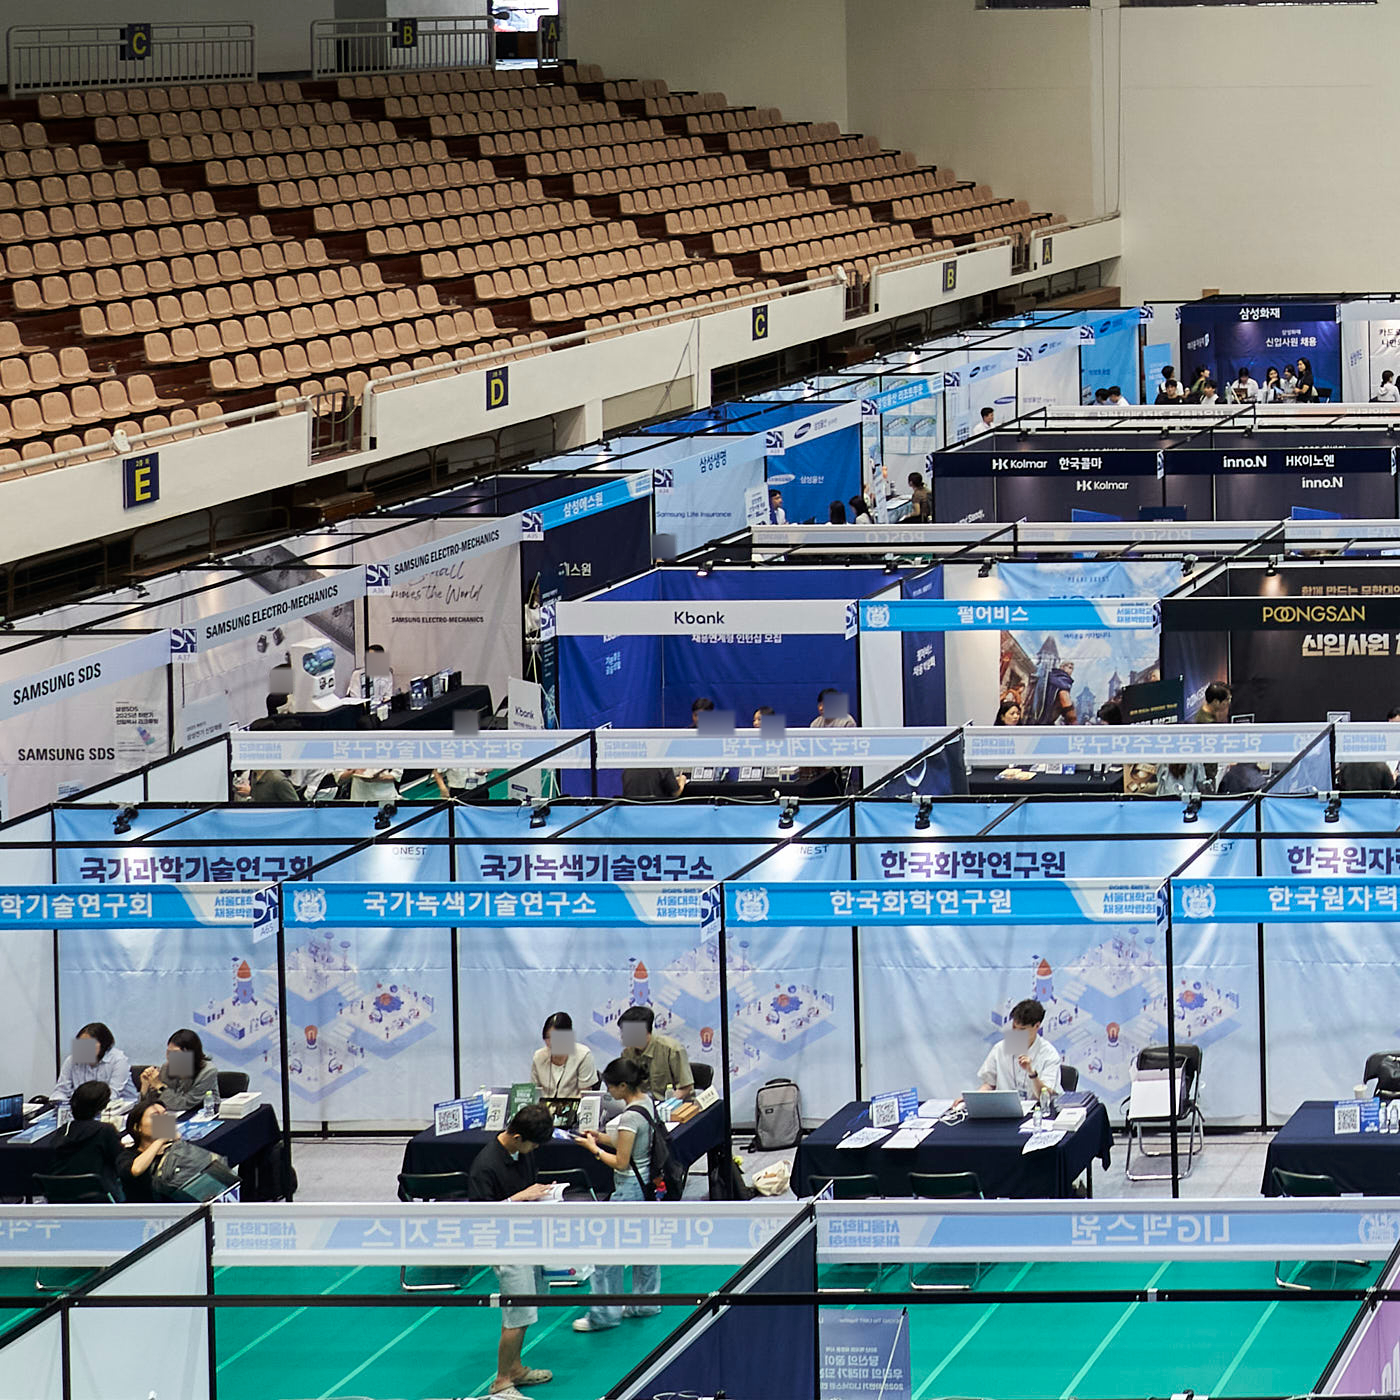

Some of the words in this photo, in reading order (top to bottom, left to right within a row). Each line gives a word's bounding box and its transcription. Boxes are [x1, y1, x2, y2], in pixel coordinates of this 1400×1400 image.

[402, 25, 414, 46] B
[547, 21, 556, 41] A
[132, 31, 146, 56] C
[946, 270, 954, 288] B
[1239, 308, 1280, 319] 삼성화재
[755, 314, 766, 338] C
[1266, 338, 1298, 347] 신입사원
[1300, 337, 1316, 347] 채용
[490, 380, 504, 406] D
[700, 451, 727, 473] 삼성생명
[1010, 459, 1047, 469] Kolmar
[1059, 457, 1102, 470] 한국콜마
[1223, 456, 1266, 468] inno.N
[1286, 455, 1334, 467] HK이노엔
[135, 470, 152, 501] E
[394, 553, 428, 575] SAMSUNG
[429, 530, 499, 563] ELECTRO-MECHANICS
[206, 612, 251, 639] SAMSUNG
[253, 585, 339, 624] ELECTRO-MECHANICS
[675, 611, 724, 624] Kbank
[958, 605, 1029, 624] 펄어비스
[1262, 605, 1366, 623] POONGSAN
[1302, 634, 1390, 657] 신입사원
[13, 672, 75, 706] SAMSUNG
[78, 663, 102, 686] SDS
[18, 749, 84, 761] SAMSUNG
[87, 748, 115, 760] SDS
[479, 853, 714, 882] 국가녹색기술연구소
[880, 849, 1066, 880] 한국화학연구원
[0, 890, 154, 920] 학기술연구회
[363, 889, 596, 918] 국가녹색기술연구소
[829, 887, 1012, 916] 한국화학연구원
